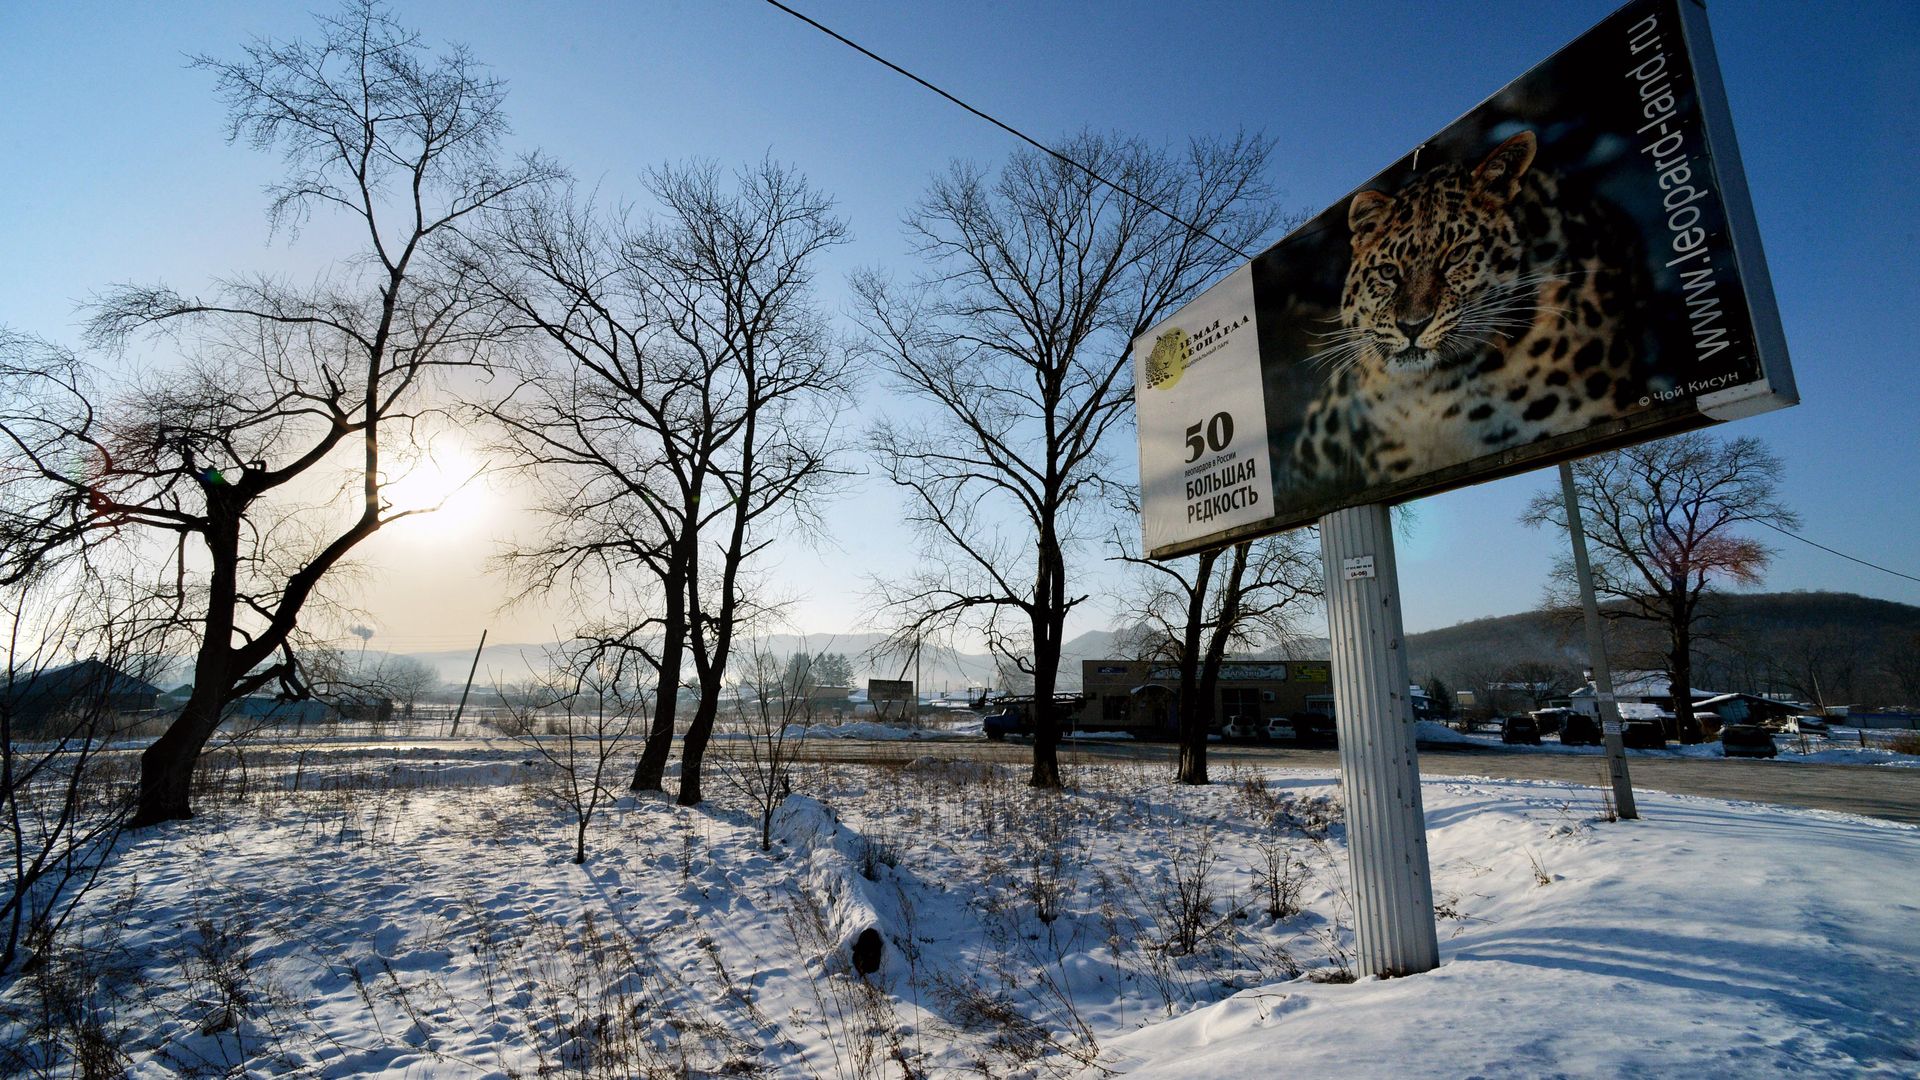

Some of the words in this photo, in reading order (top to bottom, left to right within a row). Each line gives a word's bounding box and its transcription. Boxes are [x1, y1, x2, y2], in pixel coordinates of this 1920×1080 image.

[1626, 14, 1730, 360] www.leopard-land.ru
[1653, 385, 1684, 402] Чой
[1688, 371, 1739, 393] Кисун
[1185, 412, 1234, 463] 50
[1184, 461, 1212, 477] леопардов
[1217, 452, 1236, 464] России
[1186, 458, 1255, 500] БОЛЬШАЯ
[1188, 485, 1258, 523] РЕДКОСТЬ
